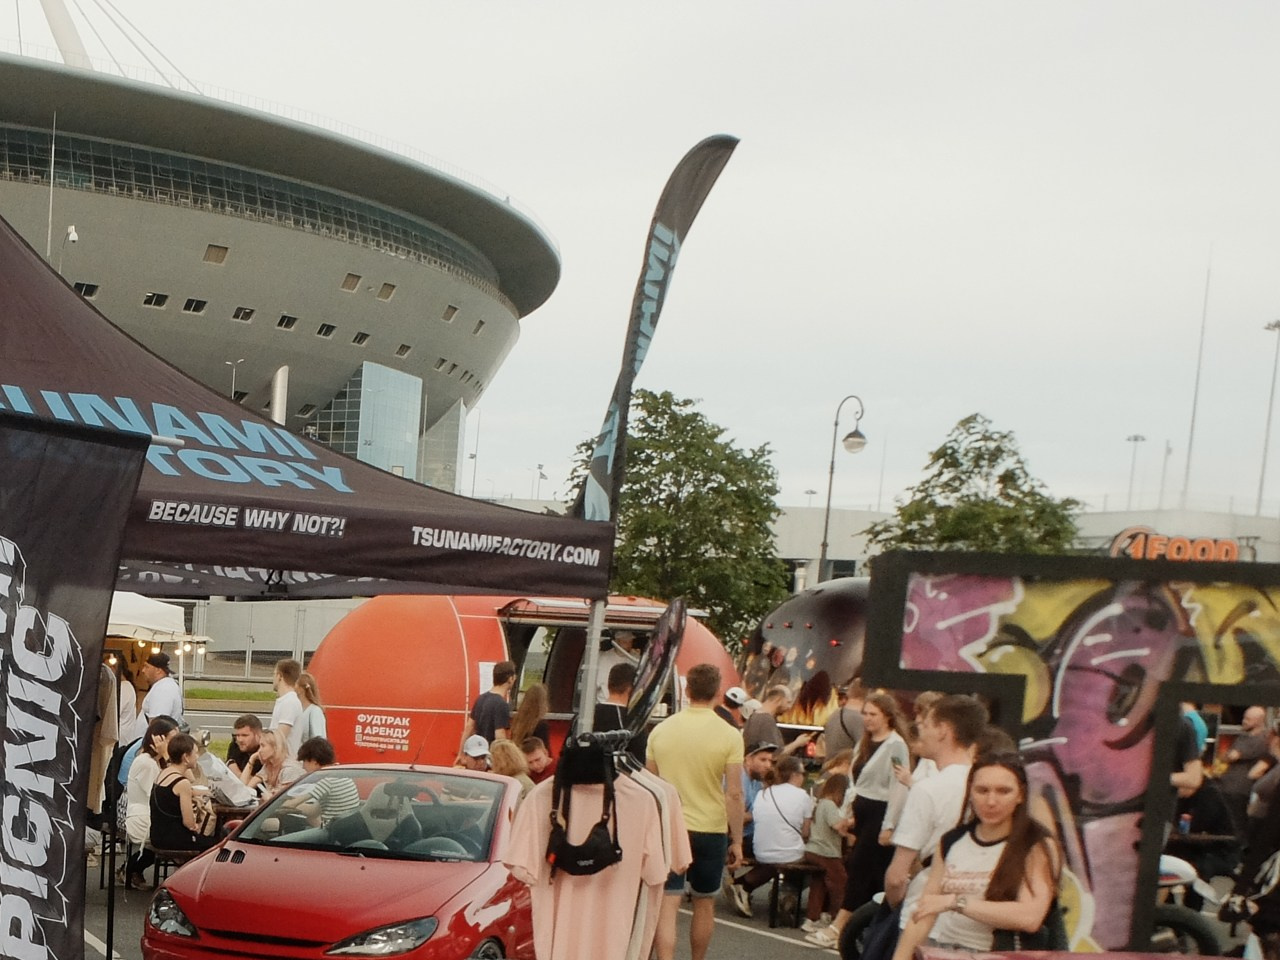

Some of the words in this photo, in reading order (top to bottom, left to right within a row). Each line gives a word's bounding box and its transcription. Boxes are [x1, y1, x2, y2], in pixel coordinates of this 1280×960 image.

[148, 501, 238, 528] BECAUSE
[244, 508, 290, 534] WHY
[291, 513, 347, 538] NOT?!
[411, 525, 601, 567] TSUNAMIFACTORY.COM
[355, 724, 363, 734] В
[364, 725, 411, 739] АРЕНДУ
[357, 713, 411, 727] ФУДТРАК
